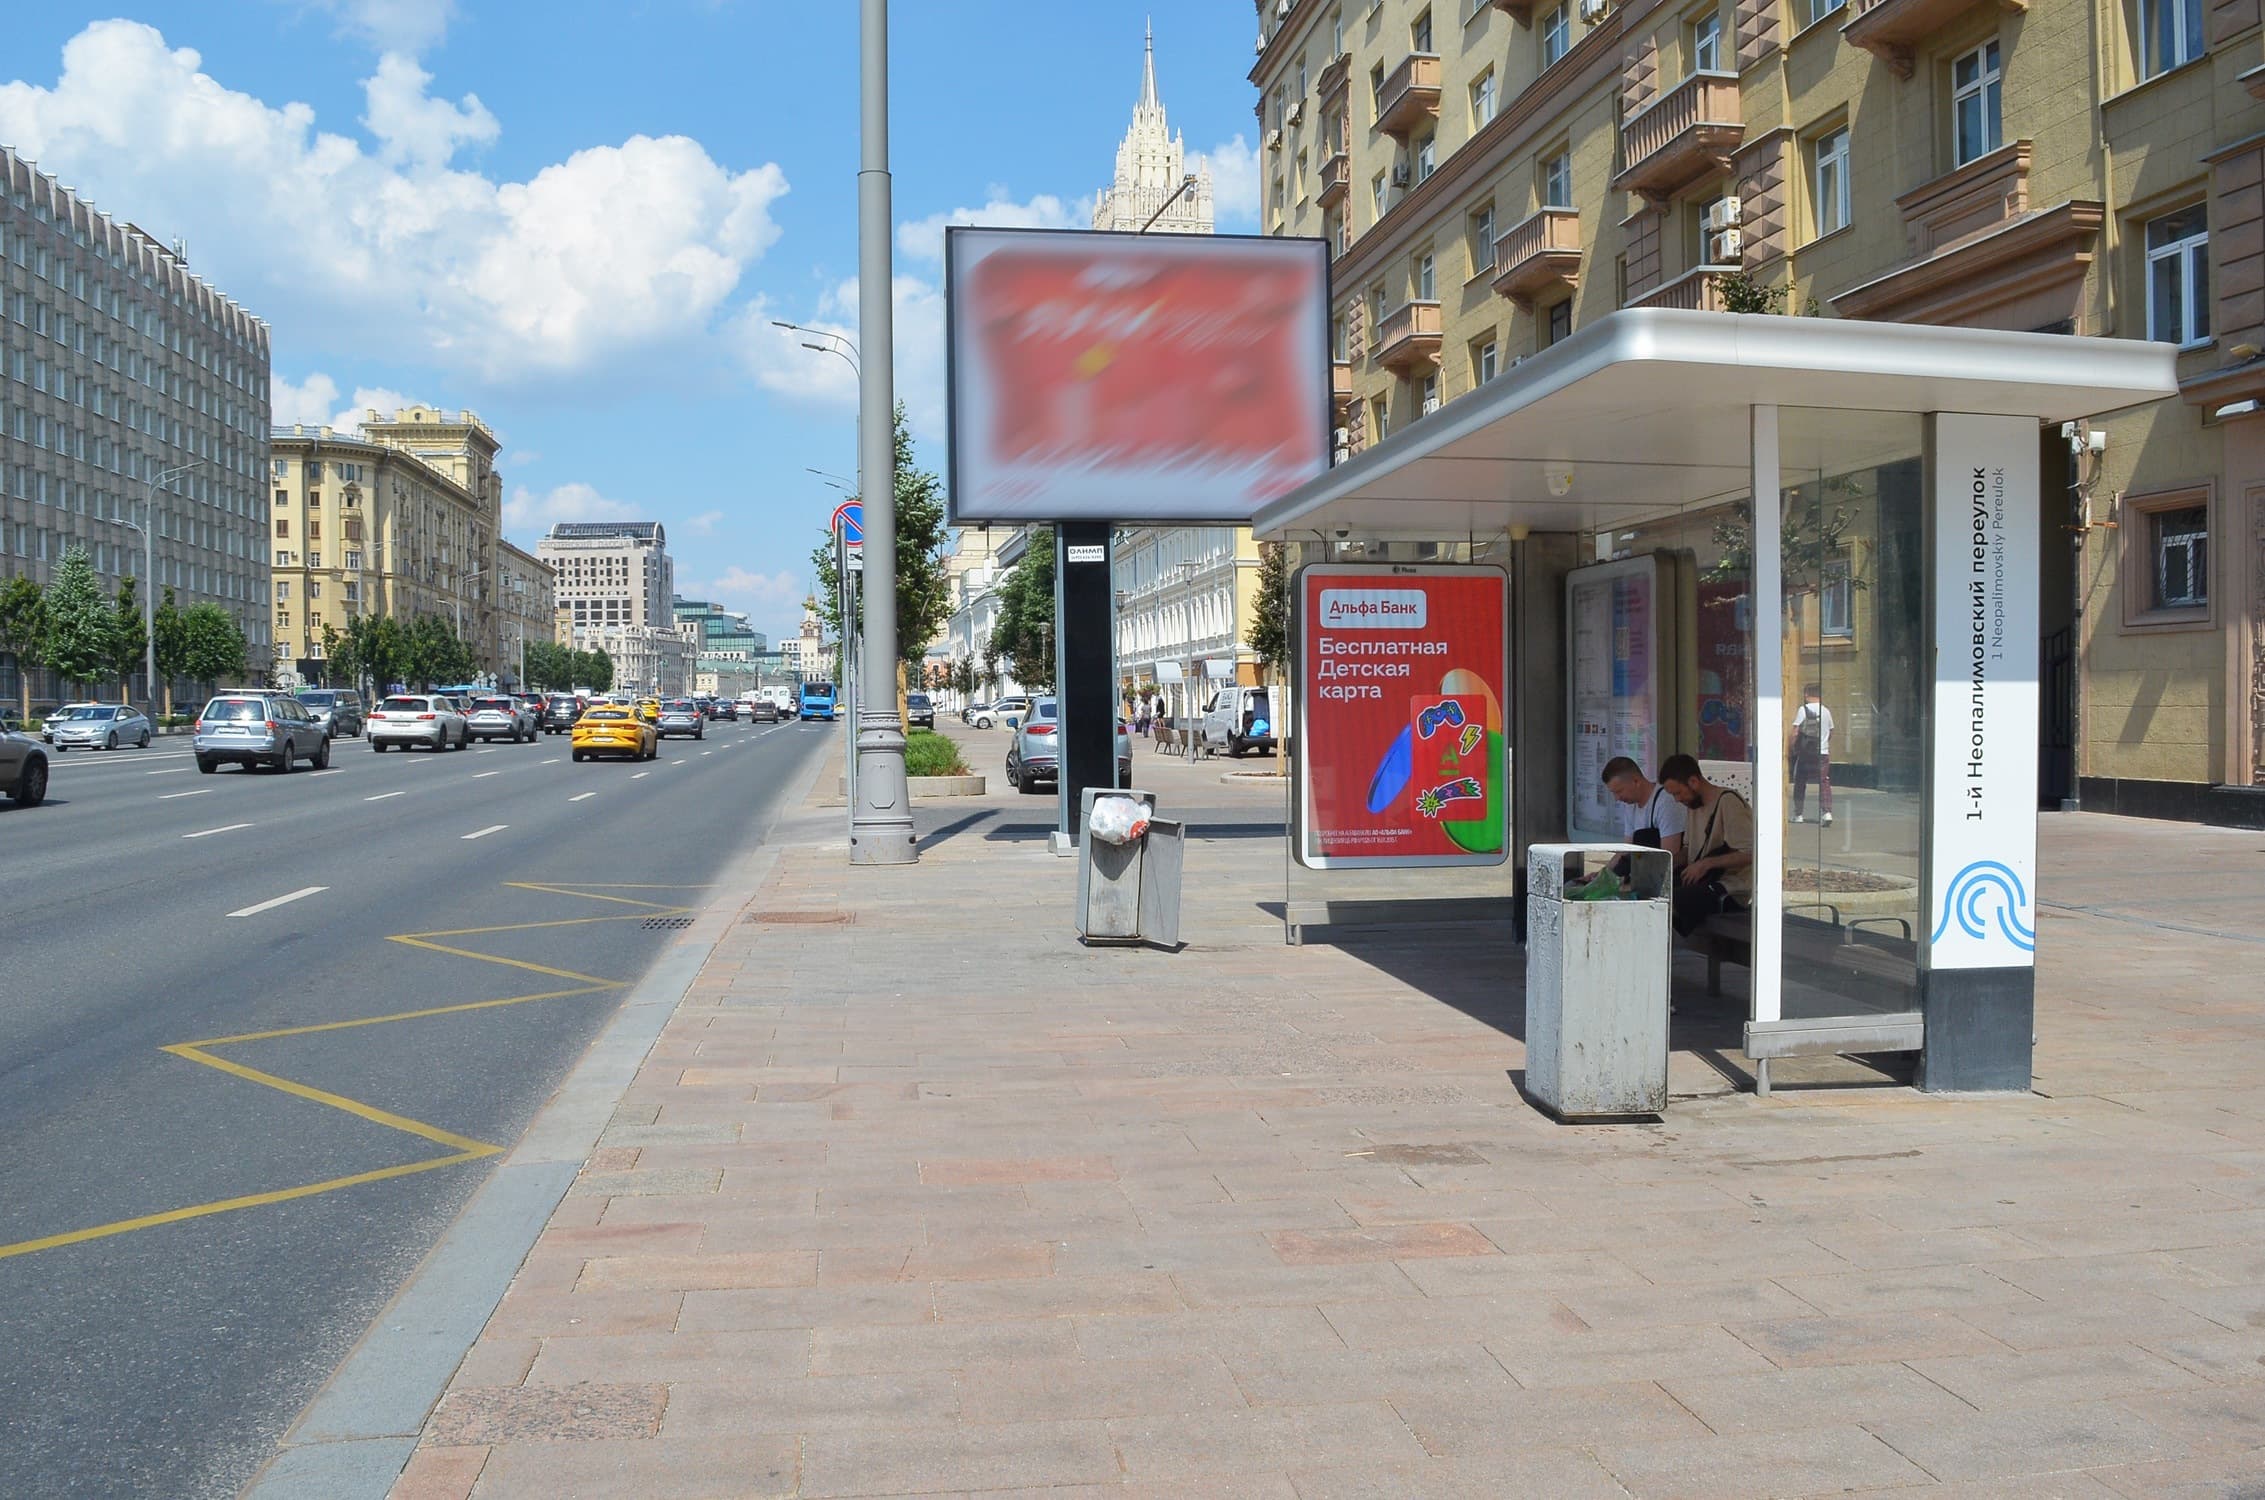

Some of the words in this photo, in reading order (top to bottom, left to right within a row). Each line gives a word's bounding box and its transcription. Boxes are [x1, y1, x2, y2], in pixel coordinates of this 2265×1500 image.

[1992, 467, 2004, 529] Pereulok
[1972, 467, 1988, 573] переулок
[1992, 534, 2005, 647] Neopalimovskiy
[1329, 600, 1378, 617] Альфа
[1381, 600, 1417, 614] Банк
[1319, 637, 1448, 655] Бесплатная
[1992, 652, 2003, 660] 1
[1318, 659, 1410, 680] Детская
[1967, 581, 1985, 777] Неопалимовский
[1319, 685, 1382, 703] карта
[1966, 787, 1983, 820] 1-й
